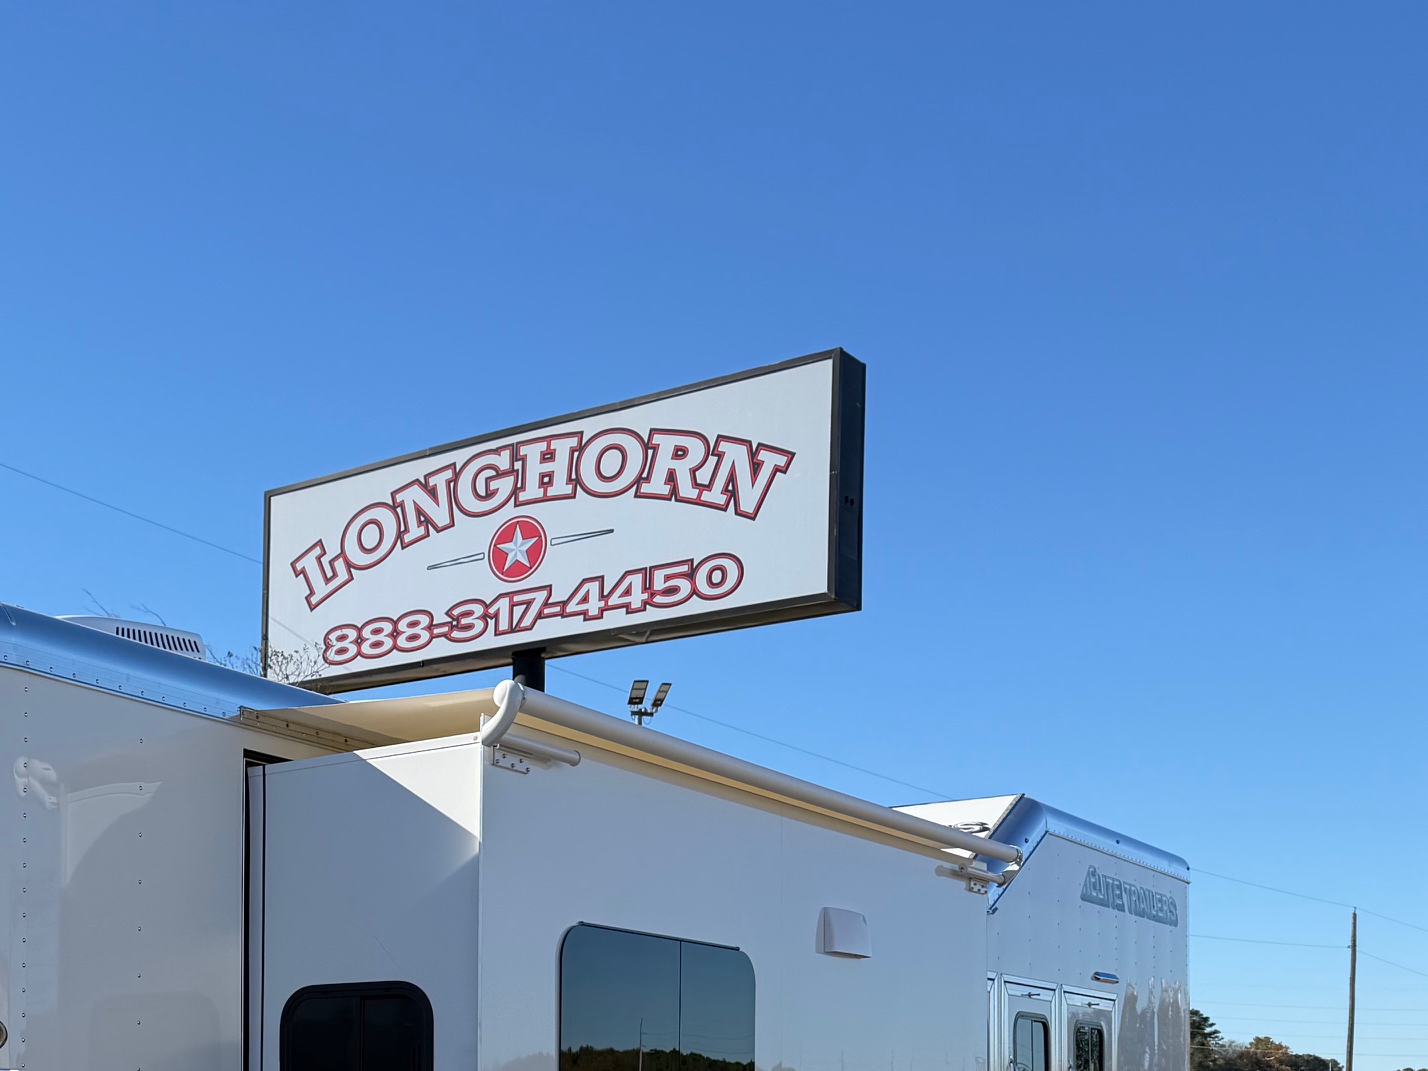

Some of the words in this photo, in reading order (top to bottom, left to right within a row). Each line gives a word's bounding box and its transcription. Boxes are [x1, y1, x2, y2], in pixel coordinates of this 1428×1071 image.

[290, 428, 796, 612] LONGHORN
[322, 553, 744, 666] 888-317-4450
[1080, 865, 1125, 913] ELITE
[1121, 880, 1178, 927] TRAILERS
